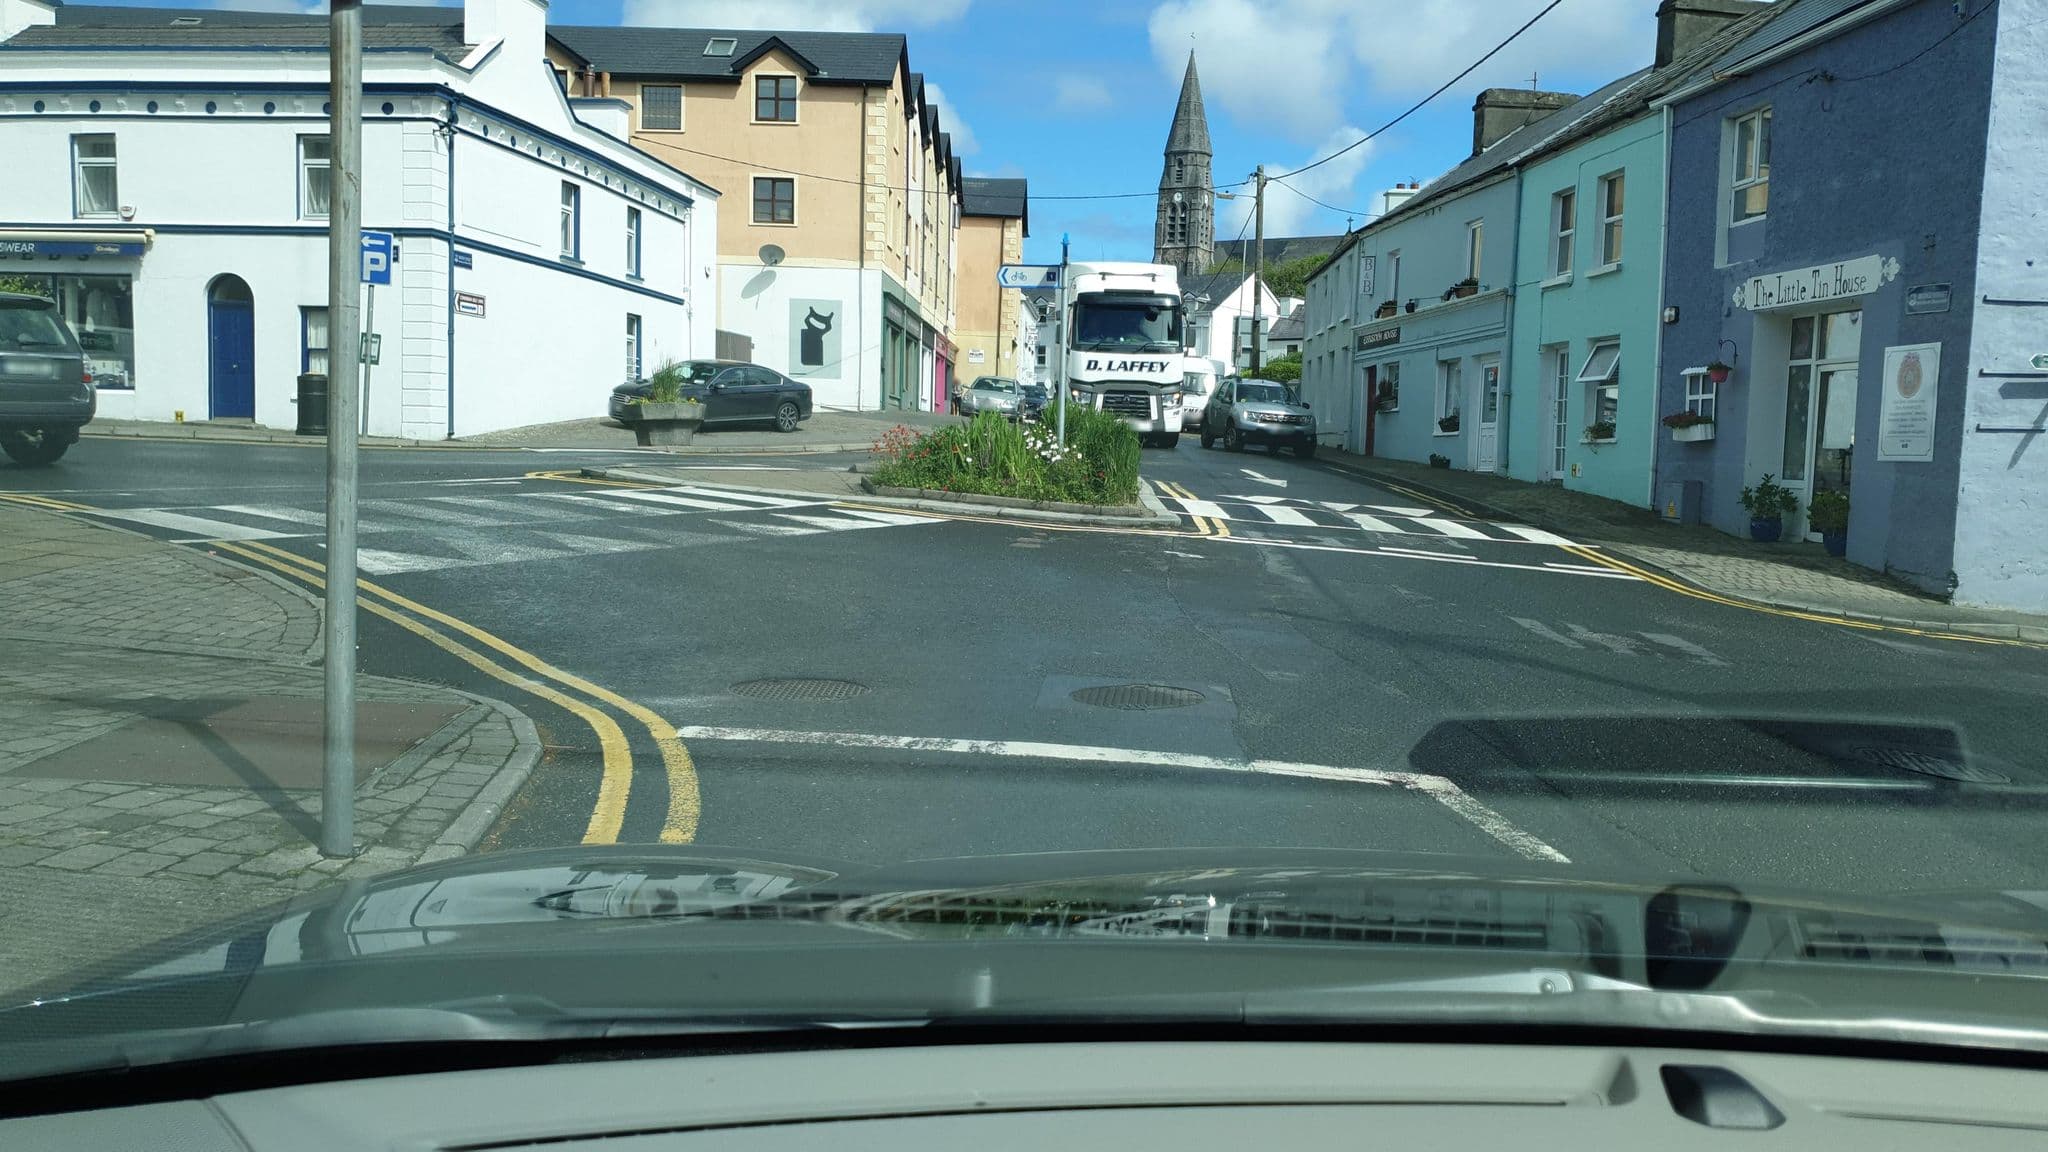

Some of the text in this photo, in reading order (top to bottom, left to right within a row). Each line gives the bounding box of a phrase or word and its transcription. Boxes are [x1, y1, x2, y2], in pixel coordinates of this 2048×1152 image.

[363, 251, 387, 281] P
[1753, 264, 1868, 308] The Little Tin House
[1085, 359, 1170, 373] D. LAFFEY
